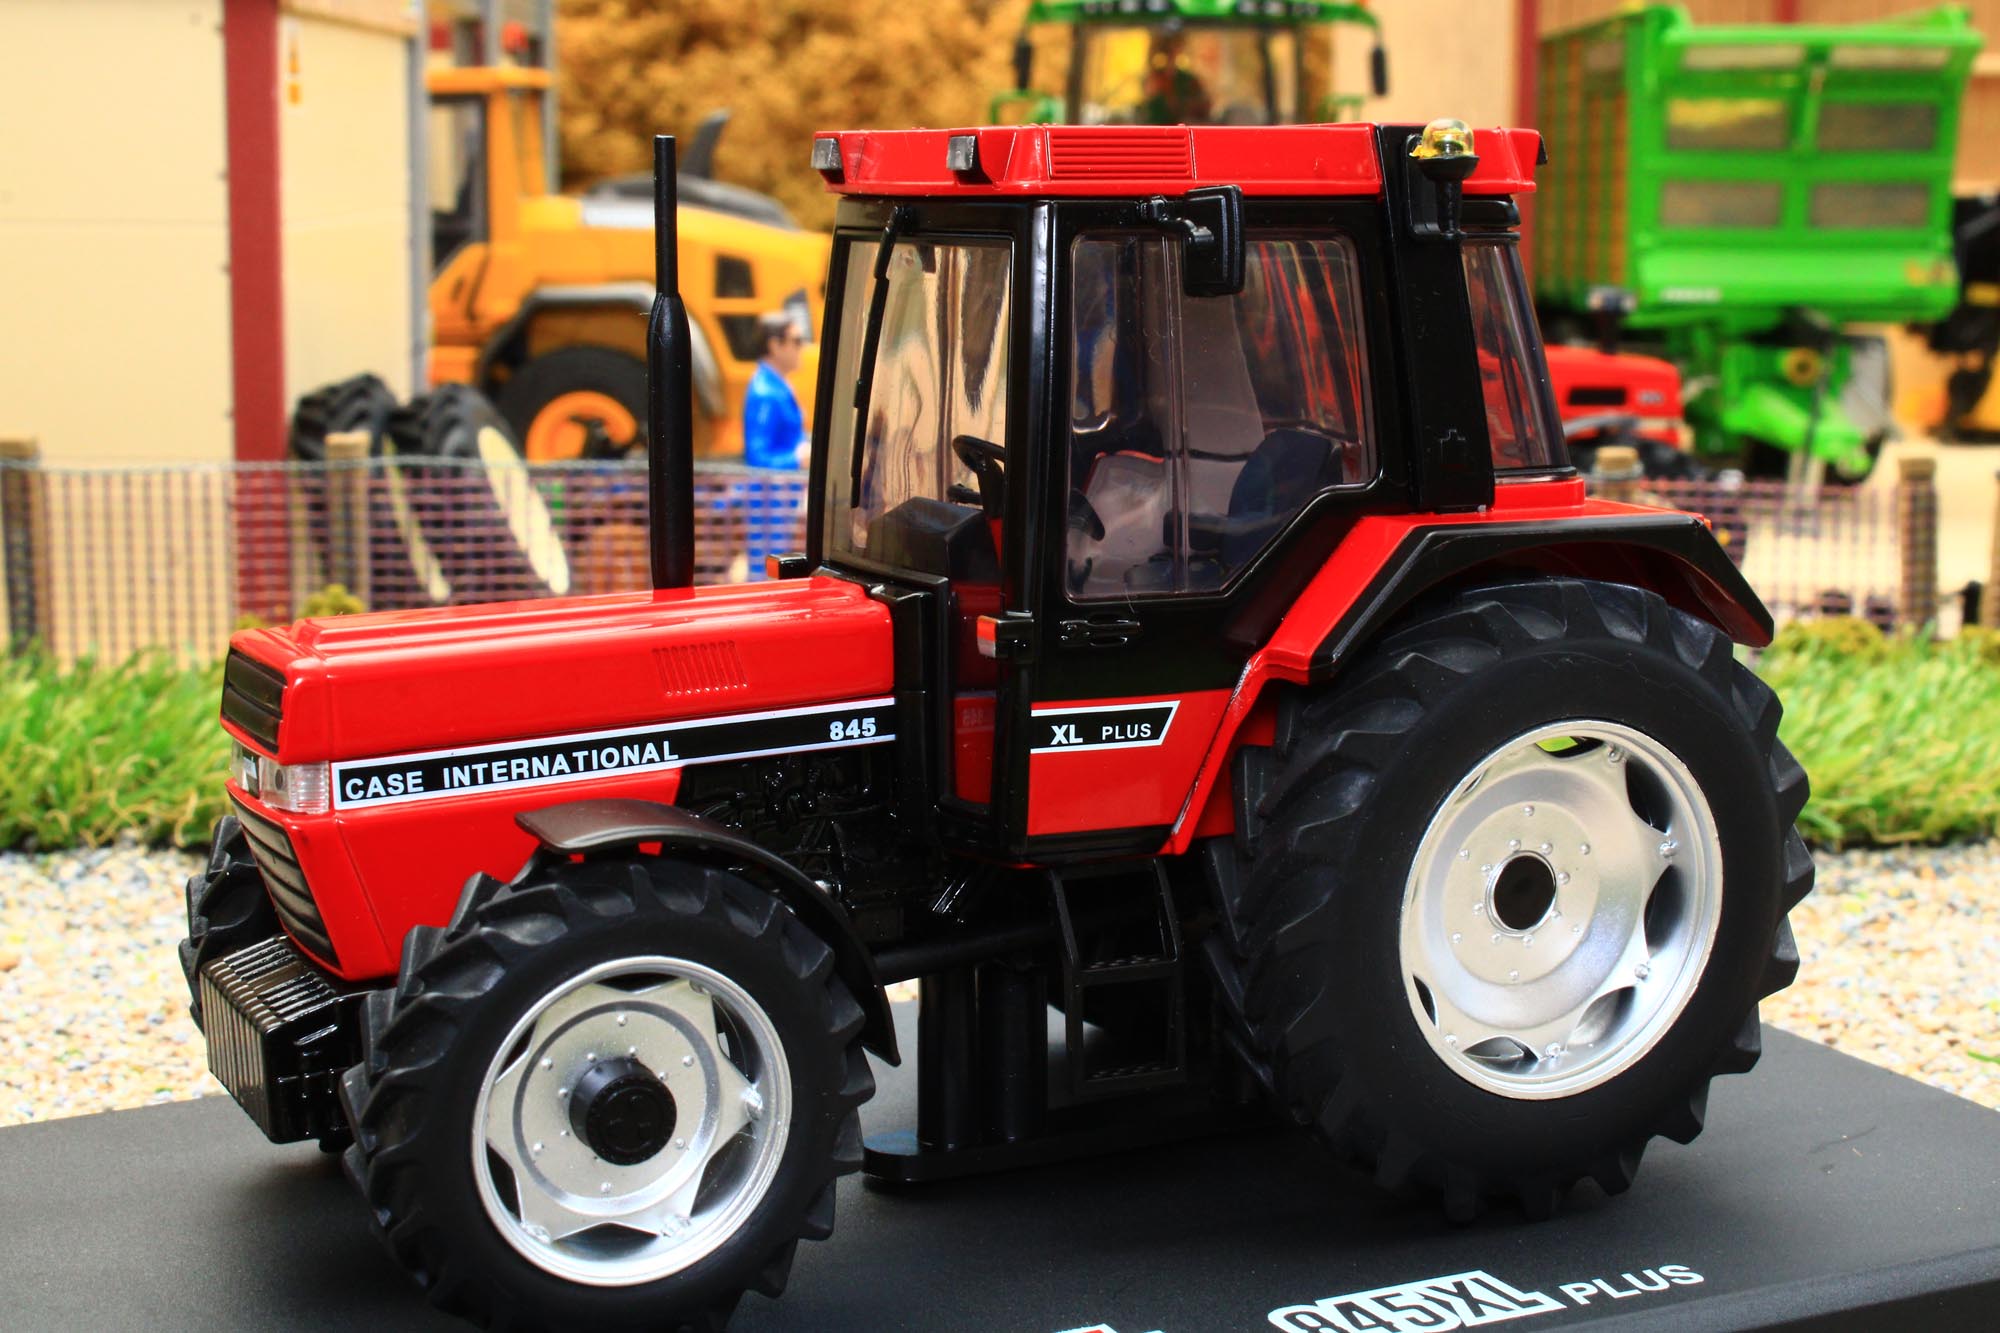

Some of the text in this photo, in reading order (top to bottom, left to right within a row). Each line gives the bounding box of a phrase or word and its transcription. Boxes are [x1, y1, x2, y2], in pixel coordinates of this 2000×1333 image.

[1050, 723, 1152, 745] XL PLUS
[345, 717, 876, 800] CASE INTERNATIONAL 845
[1559, 1264, 1704, 1304] PLUS
